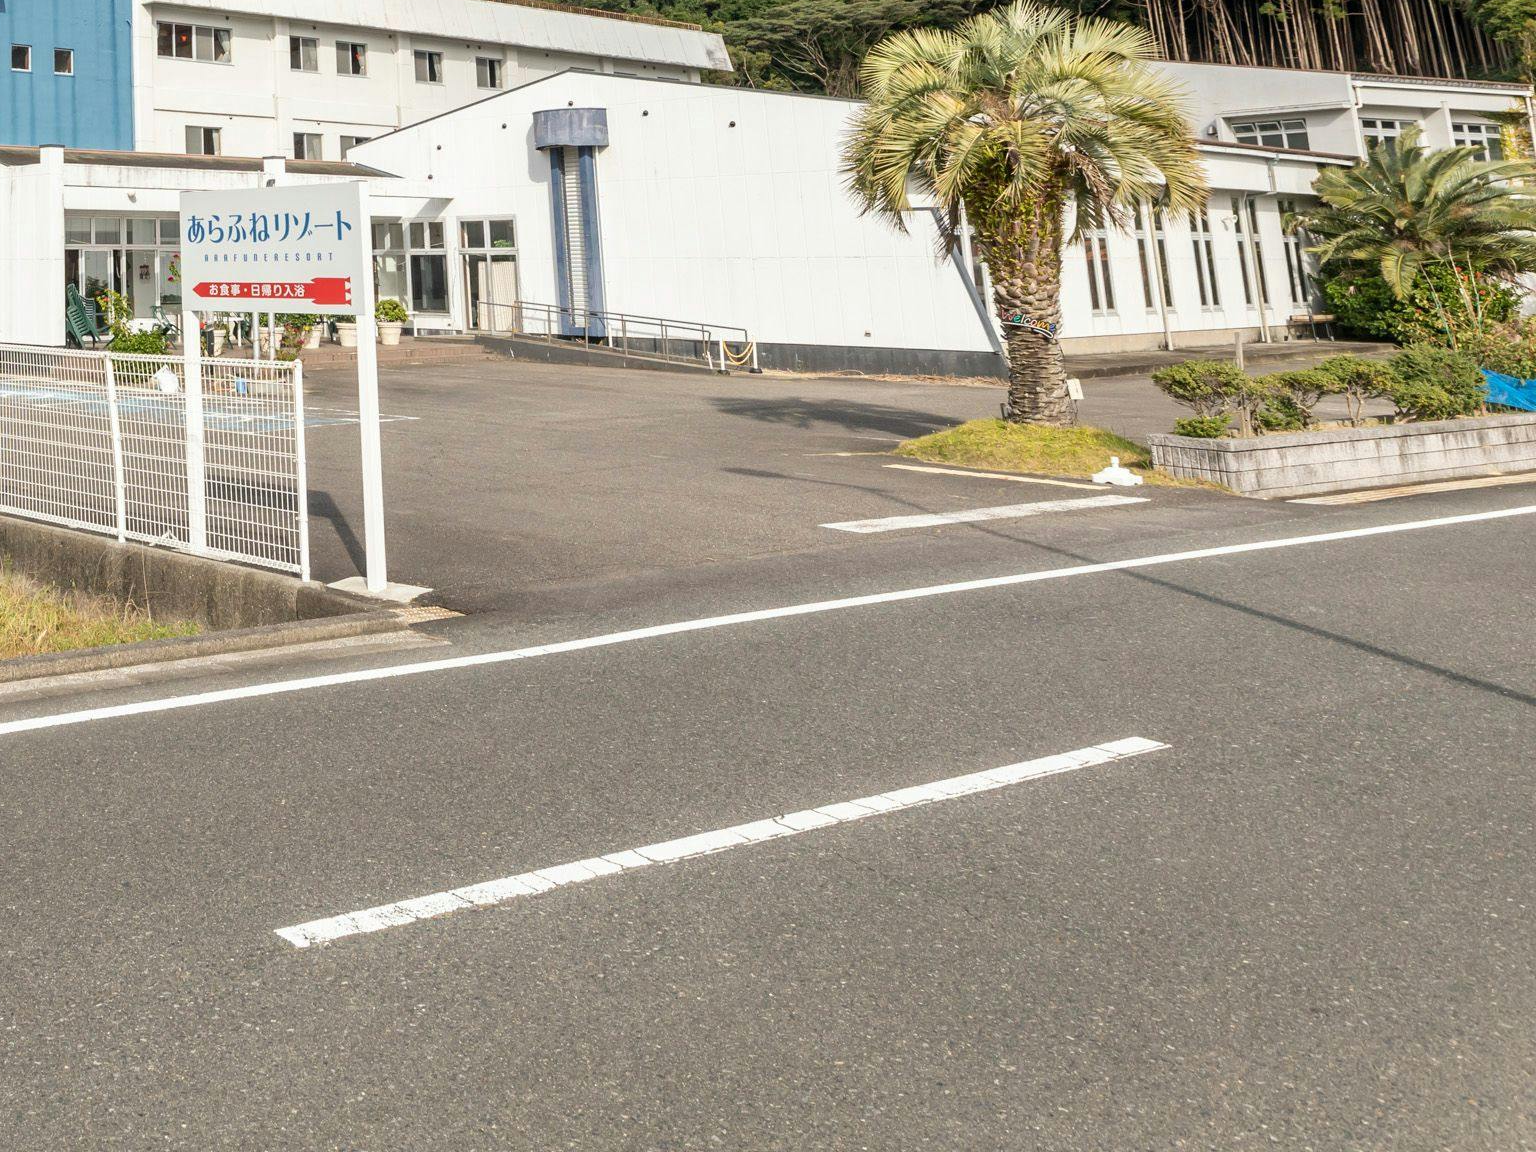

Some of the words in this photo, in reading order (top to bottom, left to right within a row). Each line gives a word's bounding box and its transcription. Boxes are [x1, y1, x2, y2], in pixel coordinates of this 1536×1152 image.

[187, 210, 352, 244] あらふねリゾート
[209, 284, 305, 297] お食事・日帰り入浴
[1001, 309, 1056, 331] Welcome
